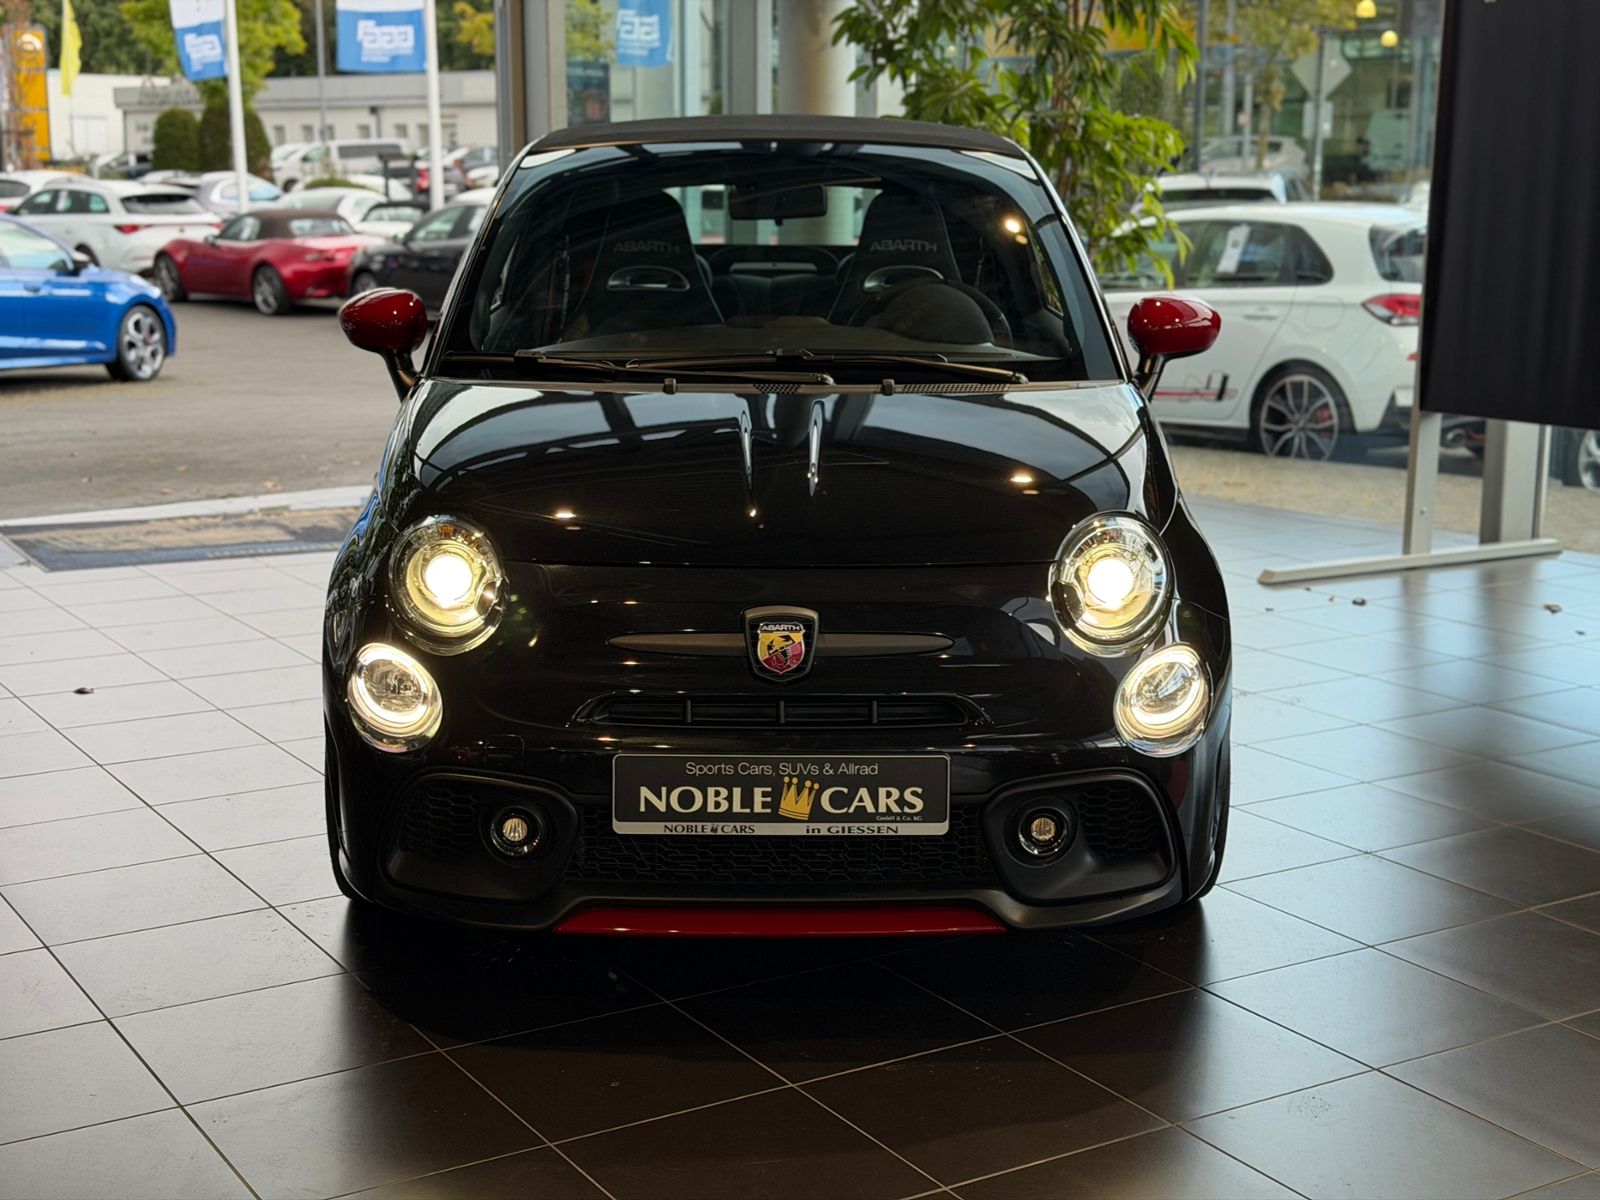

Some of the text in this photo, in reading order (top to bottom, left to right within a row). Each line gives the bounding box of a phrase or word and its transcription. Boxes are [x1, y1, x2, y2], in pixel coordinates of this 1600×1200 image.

[613, 240, 680, 253] ABARTH
[869, 239, 937, 252] ABARTH
[685, 762, 879, 776] Sports Cars, SUVs & Allrad
[639, 785, 925, 814] NOBLE CARS
[663, 824, 756, 834] NOBLE CARS
[805, 825, 899, 834] in GIESSEN
